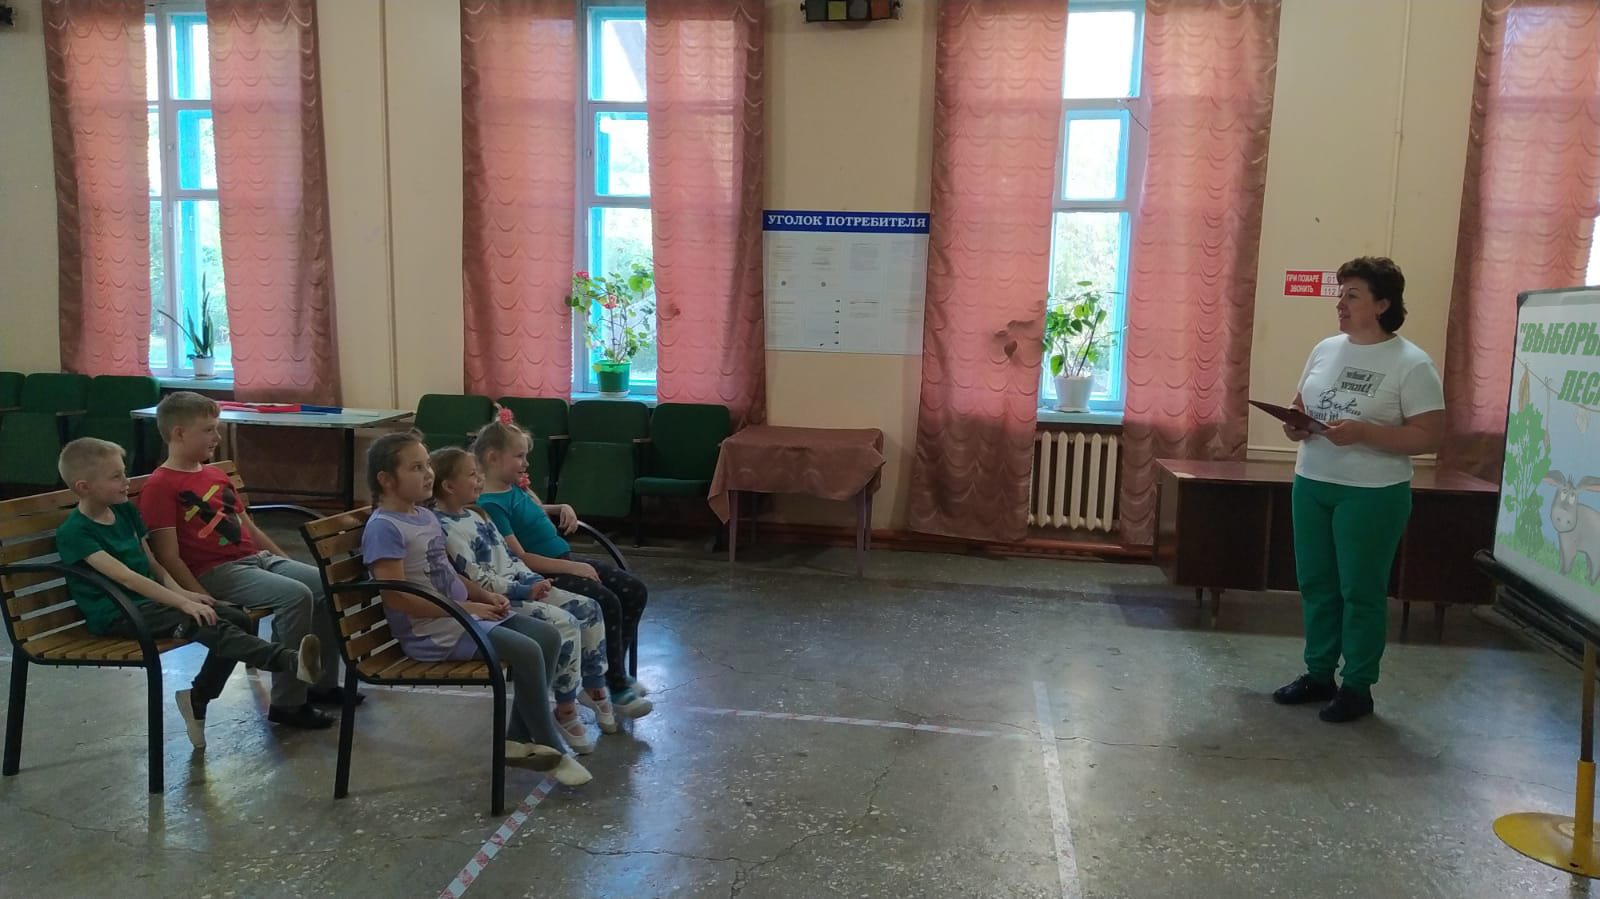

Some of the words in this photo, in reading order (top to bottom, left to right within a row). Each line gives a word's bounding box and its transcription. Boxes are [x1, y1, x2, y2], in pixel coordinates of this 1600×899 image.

[768, 214, 823, 226] УГОЛОК
[826, 216, 926, 228] ПОТРЕБИТЕЛЯ
[1286, 274, 1298, 282] ПРИ
[1299, 274, 1320, 283] ПОЖАРЕ
[1289, 284, 1314, 293] ЗВОНИТЬ
